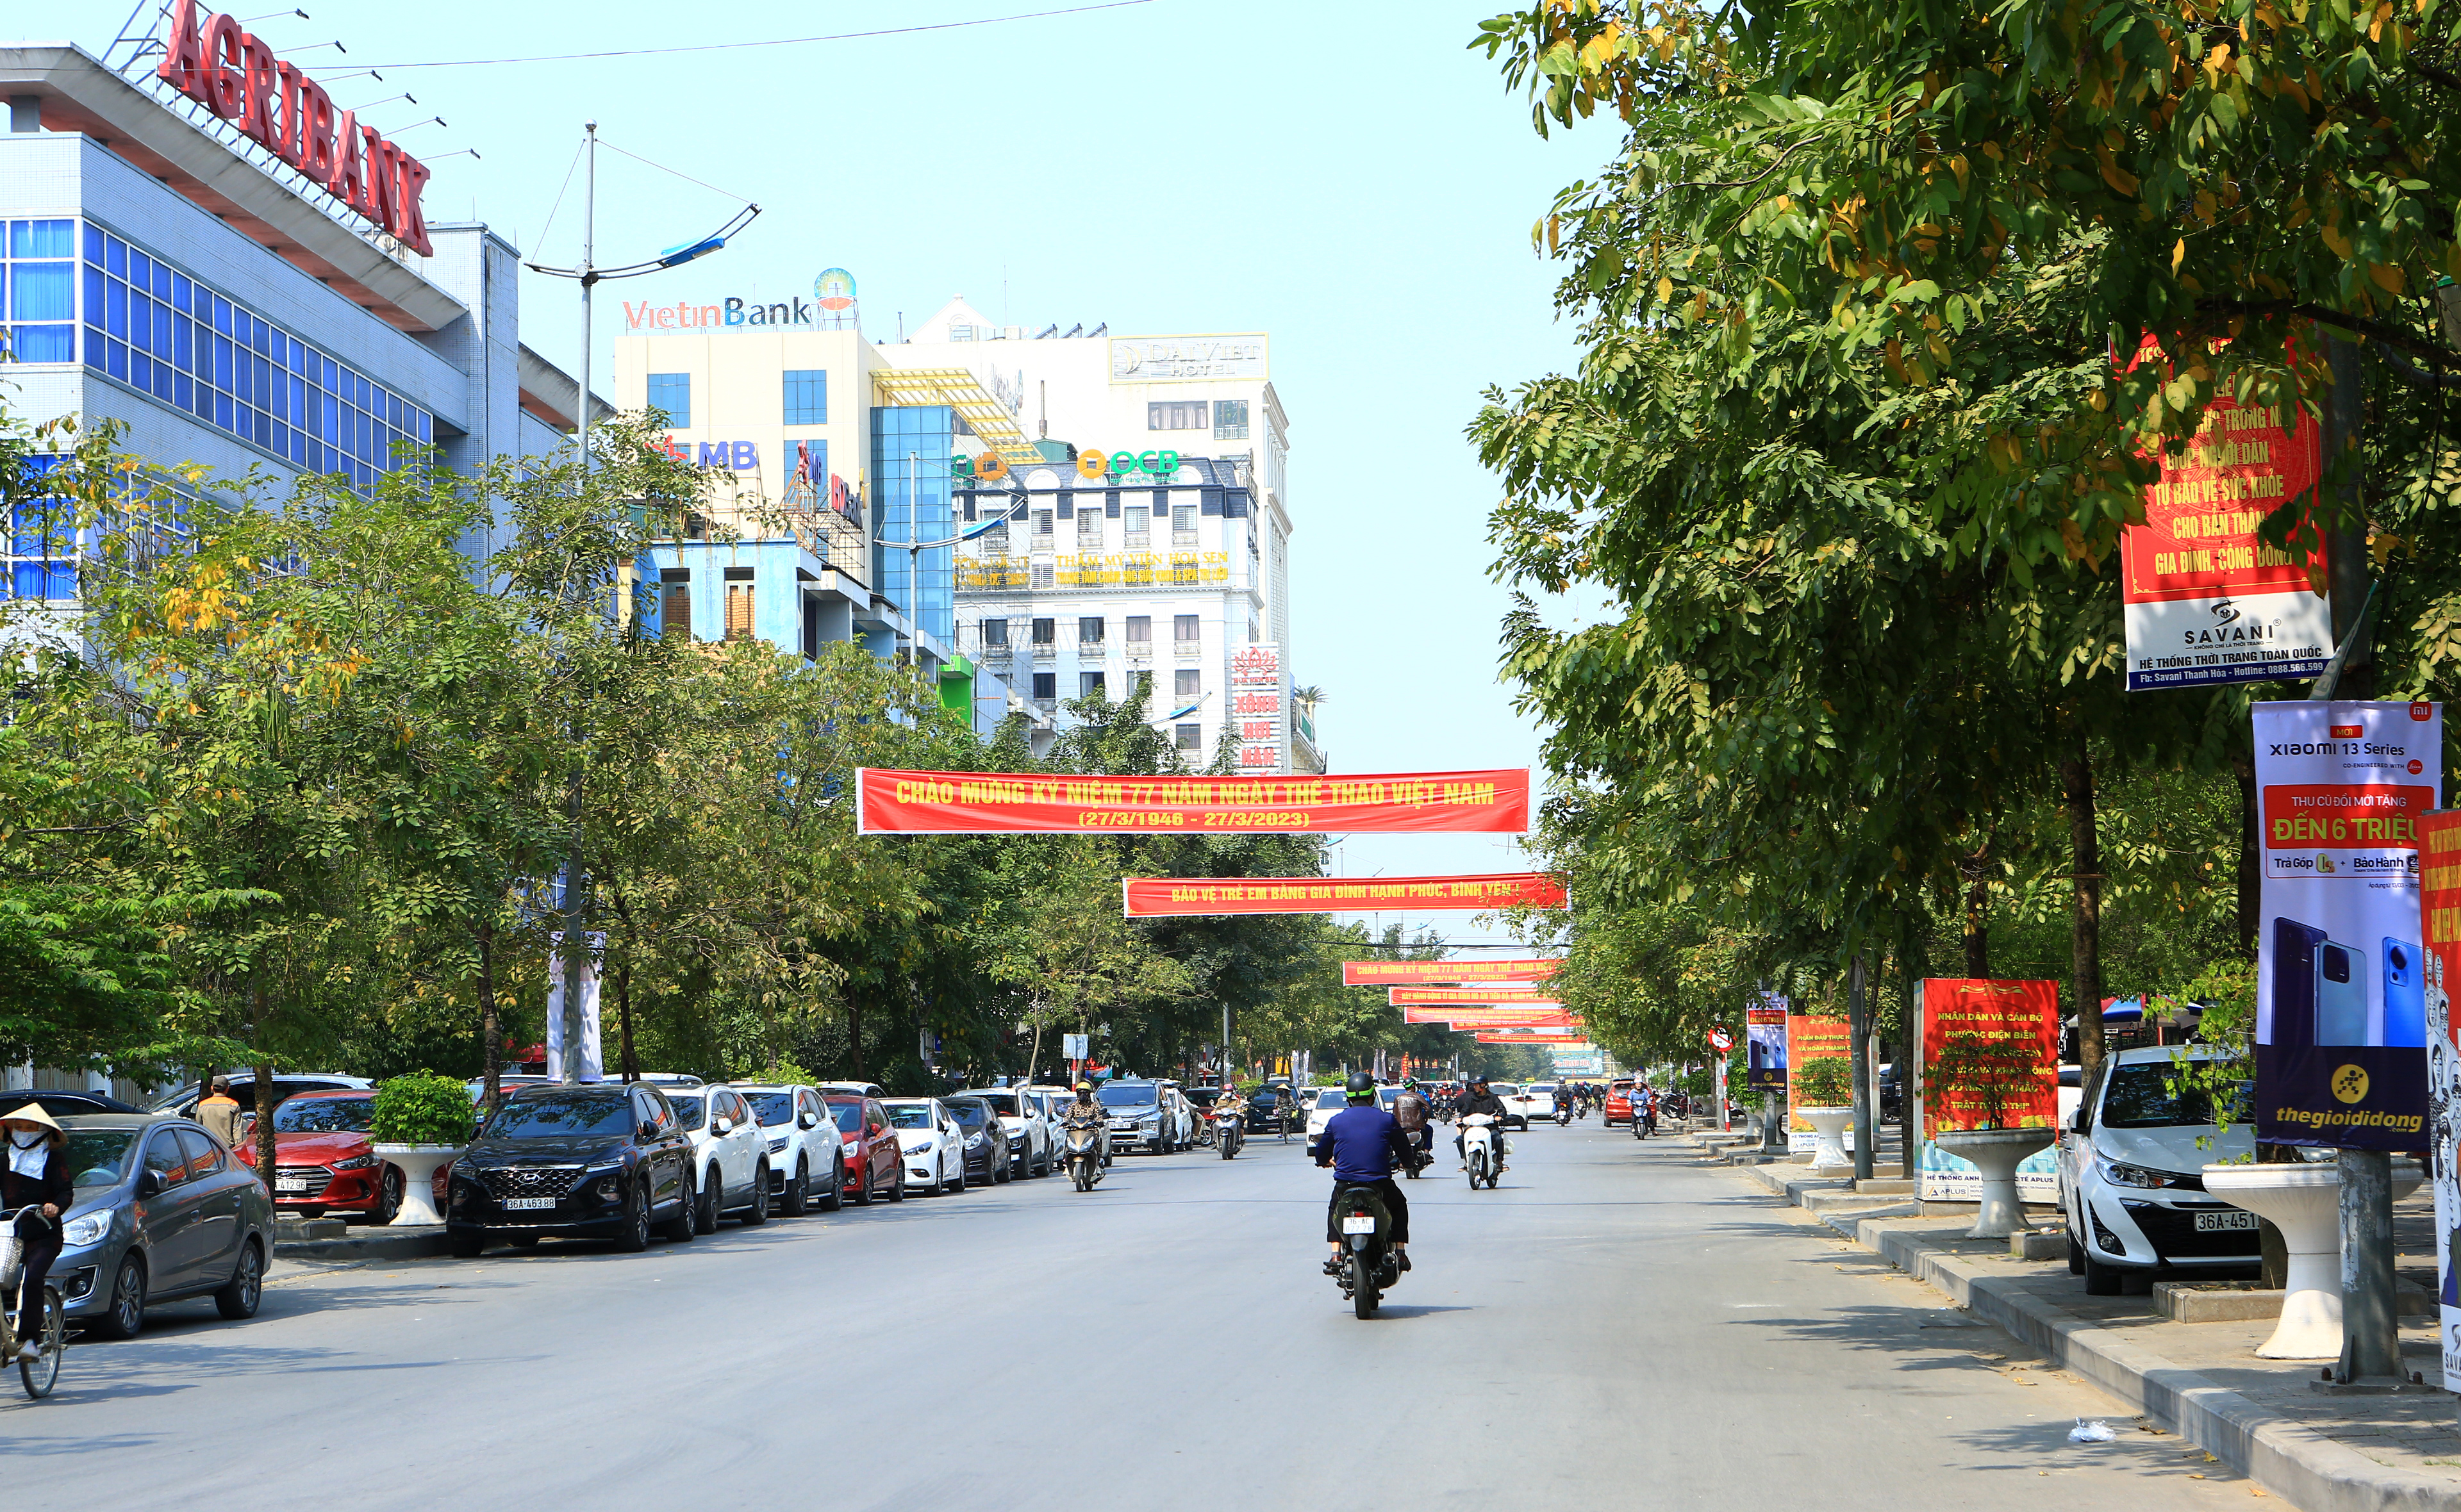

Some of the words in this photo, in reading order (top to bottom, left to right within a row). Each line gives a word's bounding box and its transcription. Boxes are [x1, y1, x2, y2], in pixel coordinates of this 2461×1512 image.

[158, 0, 433, 258] AGRIBANK
[622, 296, 811, 329] VietinBank
[1171, 363, 1236, 376] HOTEL
[2224, 407, 2266, 431] TRONG
[699, 441, 758, 470] MB
[2242, 437, 2269, 465] DÂN
[1110, 450, 1179, 475] OCB
[2154, 483, 2170, 511] TỰ
[2173, 474, 2199, 505] BẢO
[2201, 474, 2219, 507] VỆ
[2221, 473, 2246, 500] SỨC
[2251, 467, 2285, 499] KHỎE
[2173, 516, 2198, 539] CHO
[2202, 506, 2228, 538] BẢN
[1169, 552, 1198, 564] HOA
[1203, 551, 1228, 564] SEN
[2155, 552, 2176, 575] GIA
[2180, 543, 2215, 575] ĐÌNH,
[2220, 543, 2254, 575] CỘNG
[1182, 568, 1198, 581] SPA
[2184, 625, 2274, 645] SAVANI
[2233, 640, 2246, 648] THỜI
[2139, 655, 2154, 671] HỆ
[2157, 653, 2192, 668] THỐNG
[2194, 651, 2219, 665] THỜI
[2222, 651, 2257, 664] TRANG
[2261, 646, 2289, 661] TOÀN
[2293, 644, 2322, 659] QUỐC
[2140, 674, 2153, 684] Fb:
[2154, 671, 2182, 682] Savani
[2184, 670, 2208, 680] Thanh
[2210, 668, 2226, 678] Hóa
[2234, 666, 2266, 677] Hotline:
[2267, 662, 2323, 675] 0888.566.599
[1235, 693, 1278, 713] XÔNG
[1243, 721, 1271, 739] HƠI
[2337, 727, 2353, 736] MỚI
[1241, 746, 1275, 766] HÀN
[2342, 743, 2358, 755] 13
[2364, 743, 2405, 756] Series
[896, 777, 954, 804] CHÀO
[961, 777, 1025, 805] MỪNG
[1032, 776, 1059, 805] KỶ
[1066, 779, 1122, 809] NIỆM
[1128, 784, 1155, 805] 77
[1162, 780, 1213, 805] NĂM
[1219, 780, 1277, 805] NGÀY
[1284, 777, 1323, 805] THỂ
[1329, 783, 1384, 805] THAO
[1391, 778, 1438, 810] VIỆT
[1444, 783, 1495, 805] NAM
[2291, 796, 2315, 807] THU
[2317, 794, 2332, 806] CŨ
[2354, 794, 2374, 807] MỚI
[2375, 793, 2407, 809] TẶNG
[1079, 812, 1184, 827] (27/3/1946
[1204, 812, 1310, 827] 27/3/2023)
[2273, 810, 2328, 841] ĐẾN
[2332, 818, 2346, 840] 6
[2275, 857, 2292, 867] Trả
[2293, 857, 2313, 869] Góp
[2353, 855, 2376, 868] Bảo
[2378, 855, 2404, 867] Hành
[1172, 885, 1197, 902] BẢO
[1202, 885, 1217, 904] VỆ
[1220, 883, 1244, 901] TRẺ
[1248, 887, 1267, 901] EM
[1271, 883, 1306, 900] BẰNG
[1310, 885, 1332, 899] GIA
[1335, 883, 1366, 899] ĐÌNH
[1370, 885, 1405, 901] HẠNH
[1409, 882, 1447, 899] PHÚC,
[1451, 882, 1482, 897] BÌNH
[1357, 964, 1378, 974] CHÀO
[1380, 964, 1404, 974] MỪNG
[1418, 964, 1439, 975] NIỆM
[1442, 965, 1450, 973] 77
[1453, 963, 1471, 973] NĂM
[1473, 962, 1495, 973] NGÀY
[1497, 960, 1512, 973] THỂ
[1514, 963, 1534, 972] THAO
[1769, 1016, 1785, 1024] TRIỆU
[1937, 1011, 1966, 1021] NHÂN
[1968, 1011, 1989, 1021] DÂN
[1990, 1012, 2005, 1021] VÀ
[2007, 1012, 2026, 1022] CÁN
[2029, 1012, 2044, 1024] BỘ
[1988, 1030, 2011, 1040] ĐIỆN
[2014, 1030, 2036, 1039] BIÊN
[1951, 1100, 1975, 1111] TRẬT
[2276, 1107, 2423, 1133] thegioididong
[1927, 1174, 1936, 1182] HỆ
[508, 1199, 554, 1209] 36A-463.88
